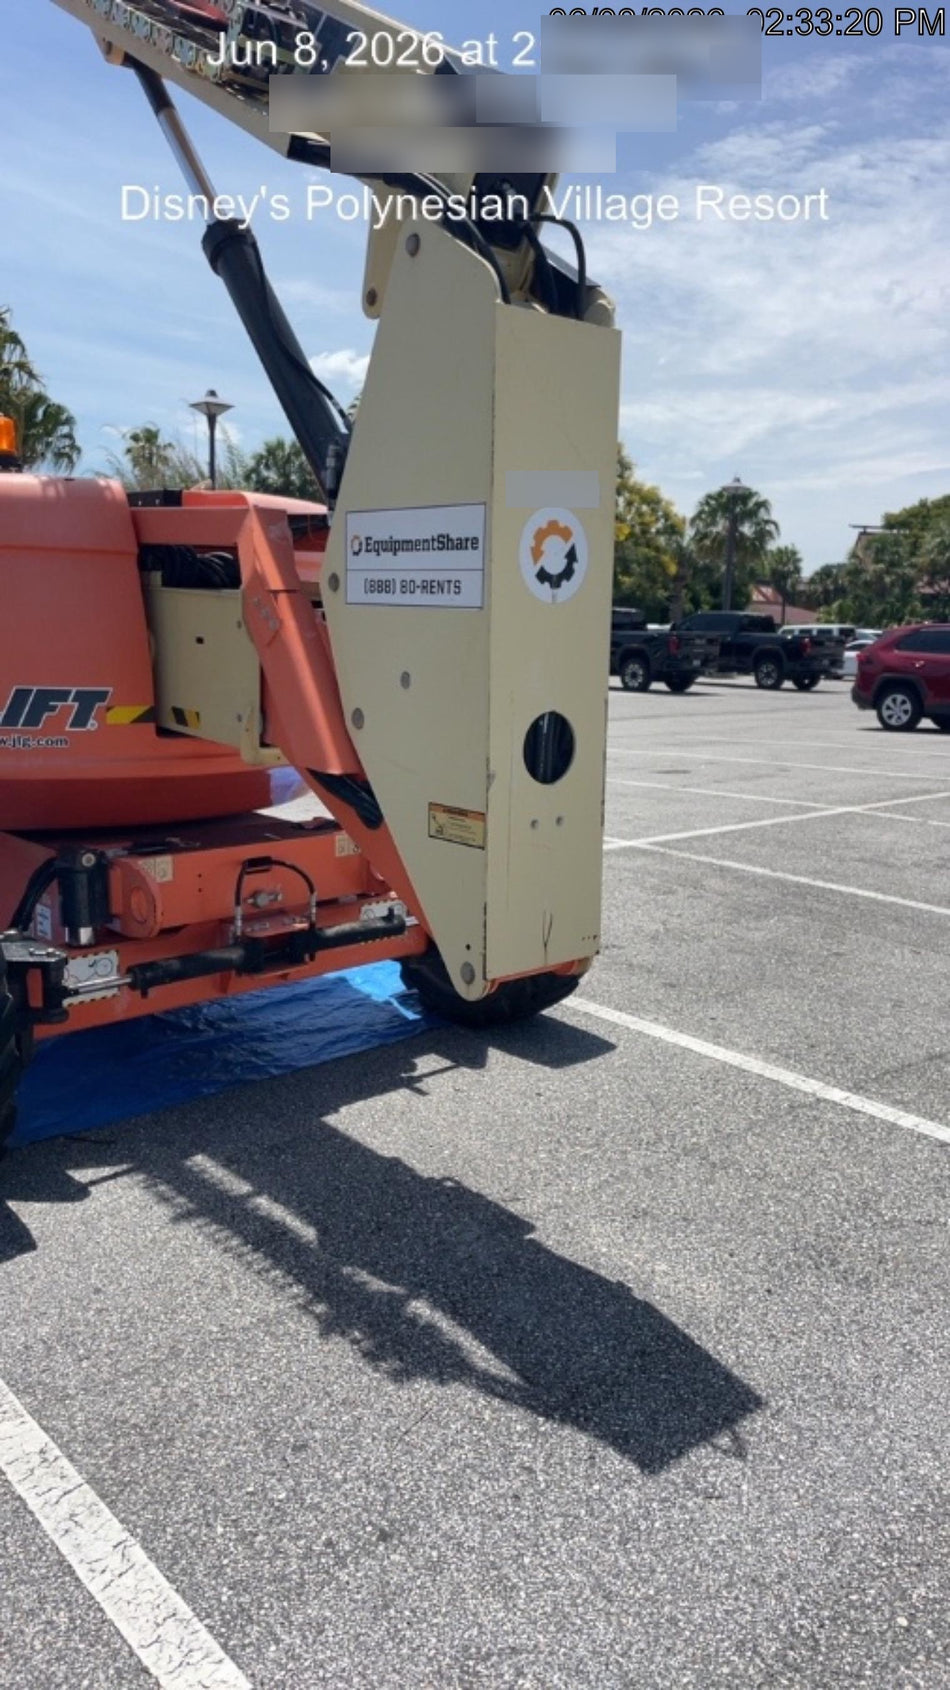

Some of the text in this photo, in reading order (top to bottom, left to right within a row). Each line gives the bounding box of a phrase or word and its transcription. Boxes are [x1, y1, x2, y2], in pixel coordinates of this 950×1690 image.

[364, 533, 480, 556] EquipmentShare
[363, 578, 462, 595] (888) 80-RENTS
[0, 686, 113, 731] IFT
